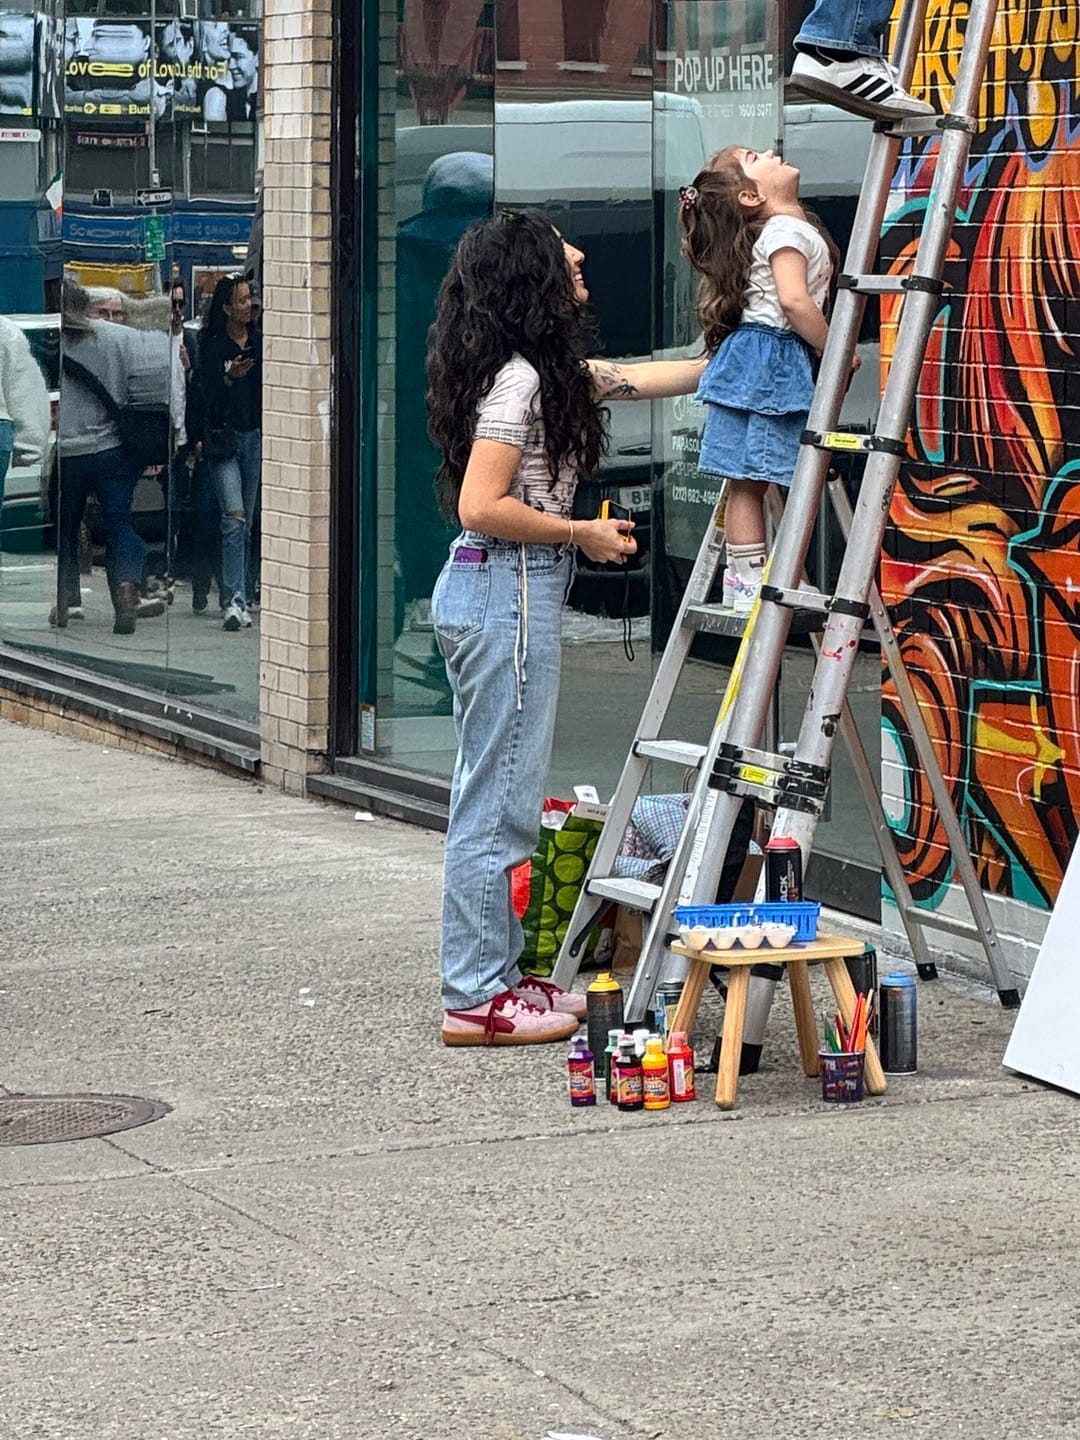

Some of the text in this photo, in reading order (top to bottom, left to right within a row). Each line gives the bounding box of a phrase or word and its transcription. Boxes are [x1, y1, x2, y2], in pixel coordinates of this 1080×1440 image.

[674, 54, 774, 93] POP UP HERE
[779, 874, 789, 903] ACK
